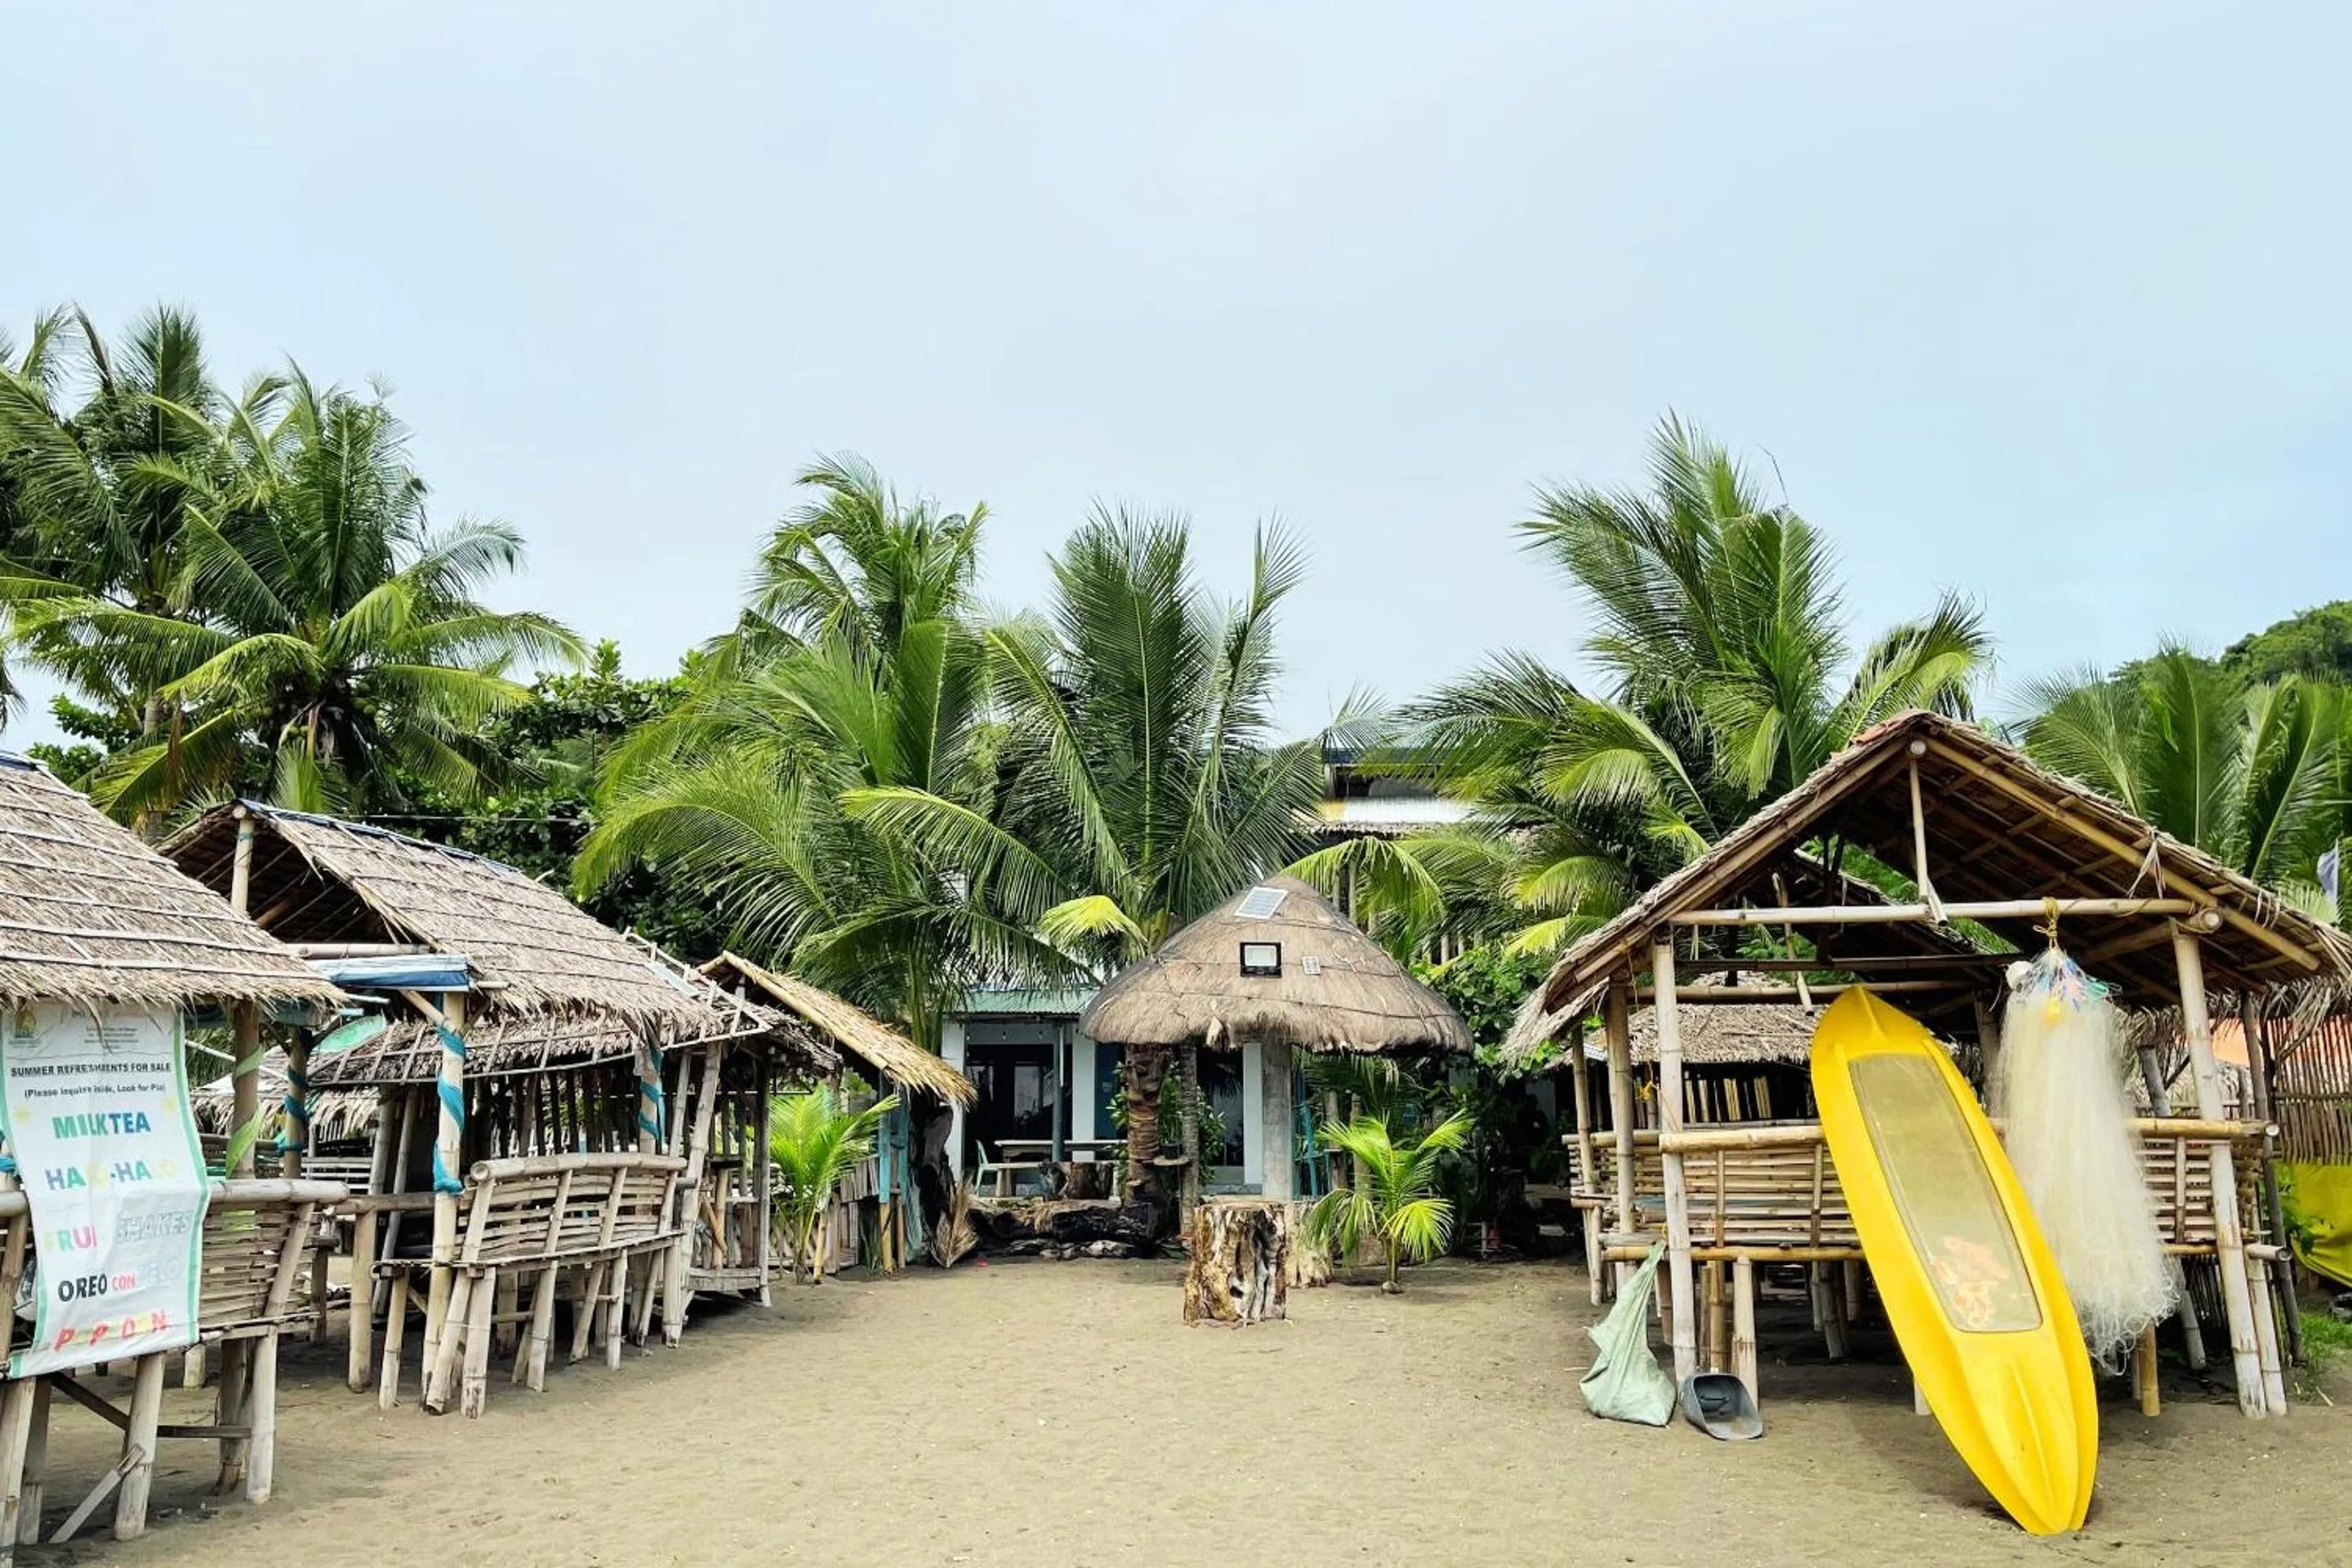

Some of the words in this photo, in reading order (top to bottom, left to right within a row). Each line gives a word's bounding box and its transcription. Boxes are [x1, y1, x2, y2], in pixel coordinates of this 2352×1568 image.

[11, 1066, 54, 1077] SUMMER
[56, 1063, 129, 1075] REFRESHMENTS
[131, 1062, 148, 1072] FOR
[150, 1062, 171, 1072] SALE
[117, 1084, 136, 1092] Look
[137, 1084, 149, 1092] for
[52, 1111, 151, 1139] MILKTEA
[57, 1273, 108, 1302] OREO
